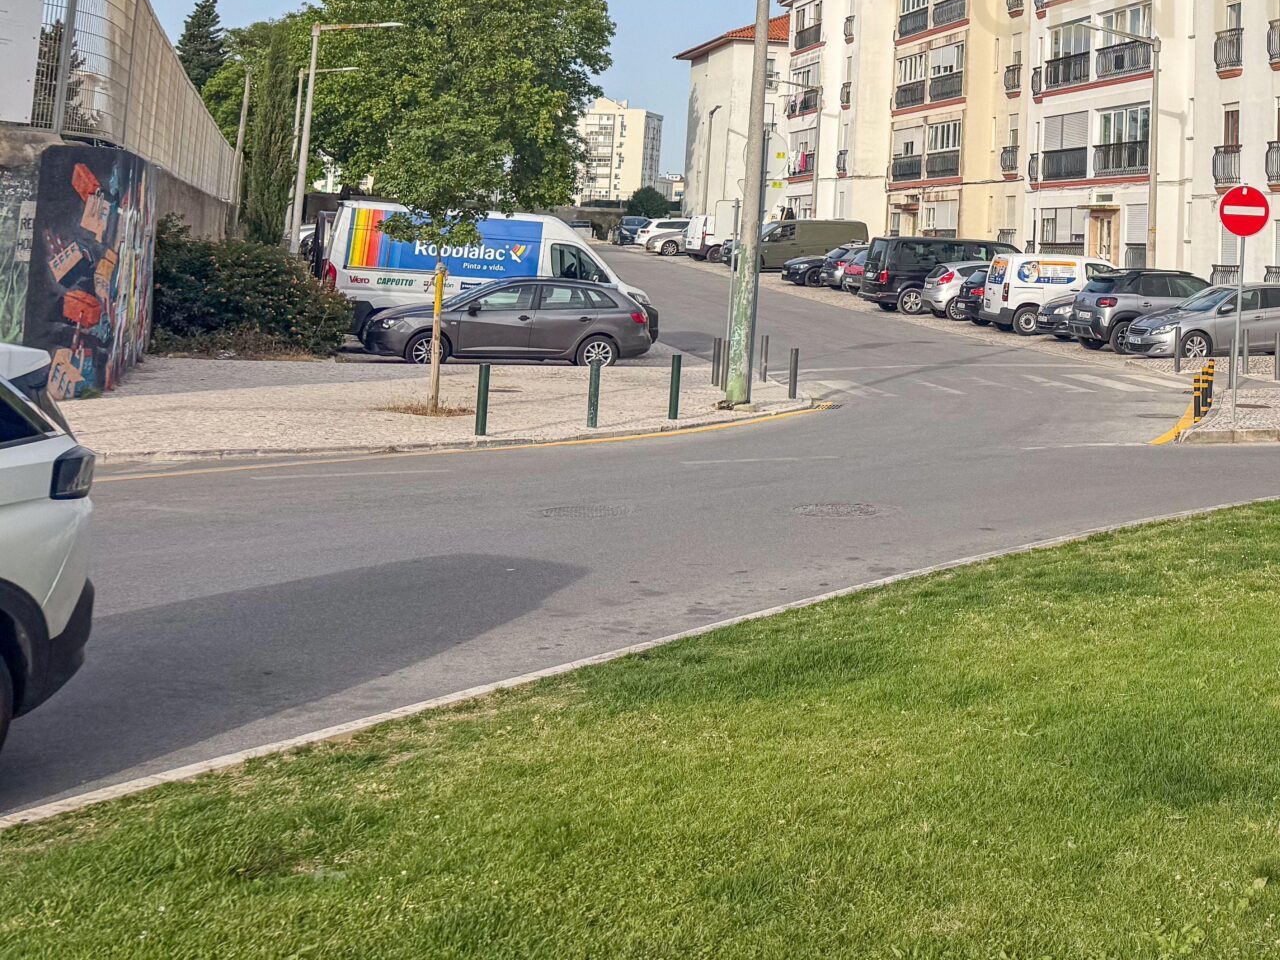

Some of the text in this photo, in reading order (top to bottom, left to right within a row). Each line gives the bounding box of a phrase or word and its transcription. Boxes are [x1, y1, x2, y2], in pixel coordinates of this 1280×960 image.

[414, 239, 506, 261] Robbialac
[463, 262, 481, 270] Pinta
[376, 277, 414, 287] CAPPOTTO
